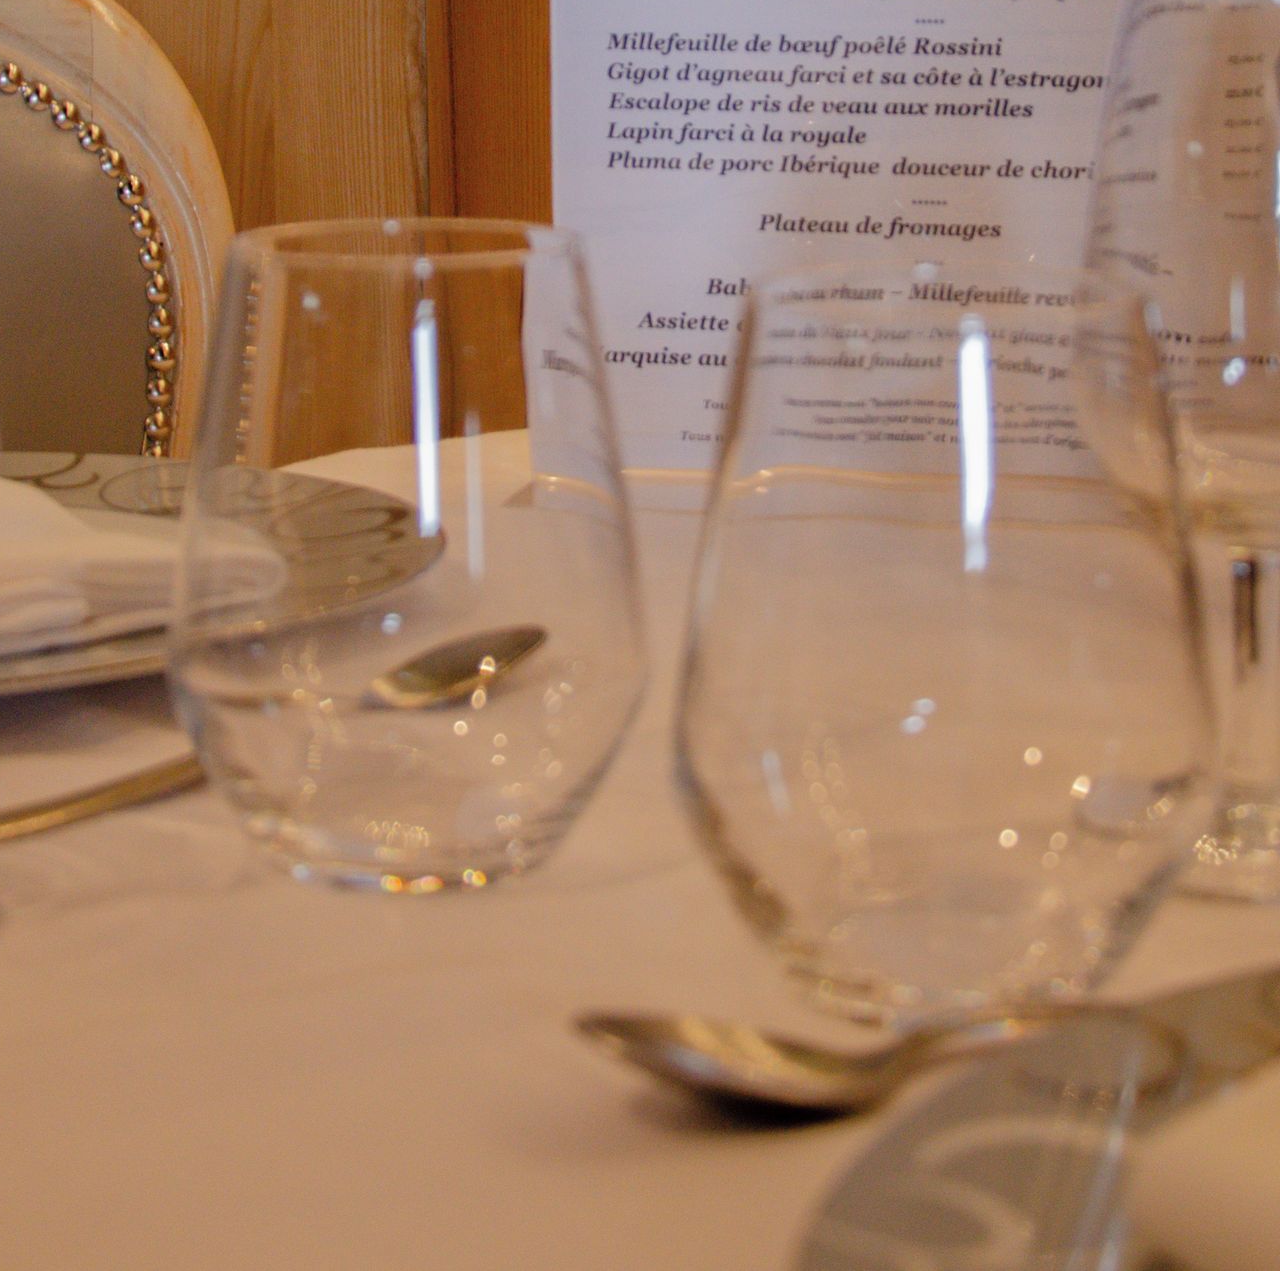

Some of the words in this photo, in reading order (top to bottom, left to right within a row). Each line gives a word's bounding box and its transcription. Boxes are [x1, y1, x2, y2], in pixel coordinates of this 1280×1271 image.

[606, 31, 739, 56] Millefeuille
[743, 33, 773, 54] de
[778, 33, 844, 59] bœuf
[841, 35, 907, 60] poêlé
[912, 36, 1003, 57] Rossini
[606, 61, 671, 86] Gigot
[676, 62, 784, 85] d'agneau
[786, 66, 847, 86] farci
[851, 68, 875, 85] et
[879, 71, 907, 86] sa
[912, 66, 963, 87] côte
[967, 67, 984, 87] à
[607, 91, 711, 116] Escalope
[716, 92, 745, 113] de
[749, 93, 782, 114] ris
[787, 94, 816, 115] de
[821, 100, 878, 116] veau
[882, 102, 930, 117] aux
[934, 97, 1035, 119] morilles
[605, 121, 674, 145] Lapin
[674, 121, 736, 146] farci
[739, 123, 755, 143] à
[761, 123, 784, 144] la
[789, 124, 868, 149] royale
[606, 149, 682, 171] Pluma
[687, 151, 715, 172] de
[718, 158, 774, 177] porc
[778, 153, 881, 180] Ibérique
[891, 156, 992, 178] douceur
[995, 158, 1025, 179] de
[757, 212, 850, 235] Plateau
[854, 215, 884, 236] de
[883, 215, 1003, 243] fromages
[908, 282, 1029, 306] Millefeuille
[638, 311, 730, 331] Assiette
[603, 346, 692, 368] arquise
[698, 352, 728, 367] au
[703, 398, 729, 410] Tou
